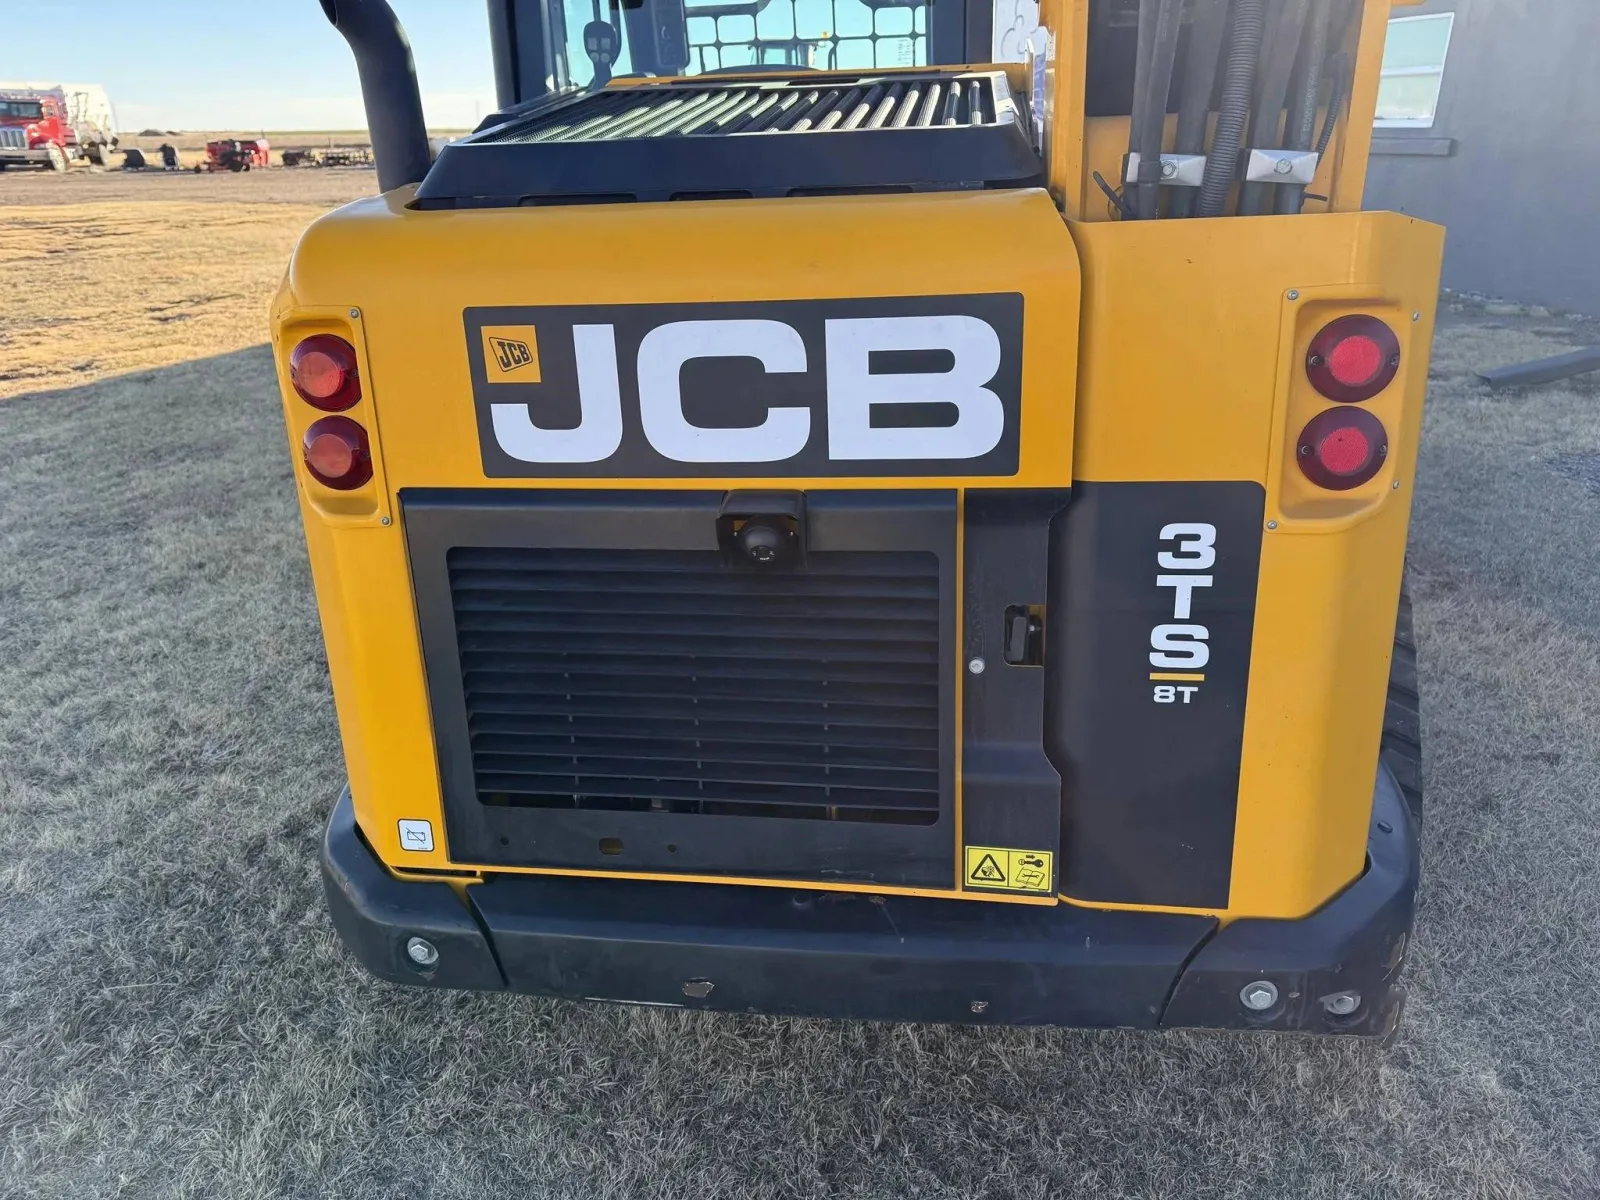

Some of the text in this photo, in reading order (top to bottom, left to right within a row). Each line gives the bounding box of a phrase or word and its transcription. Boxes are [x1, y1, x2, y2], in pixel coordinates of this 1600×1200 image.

[496, 340, 531, 369] JCB
[490, 314, 1005, 464] JCB
[1153, 685, 1199, 704] 8T
